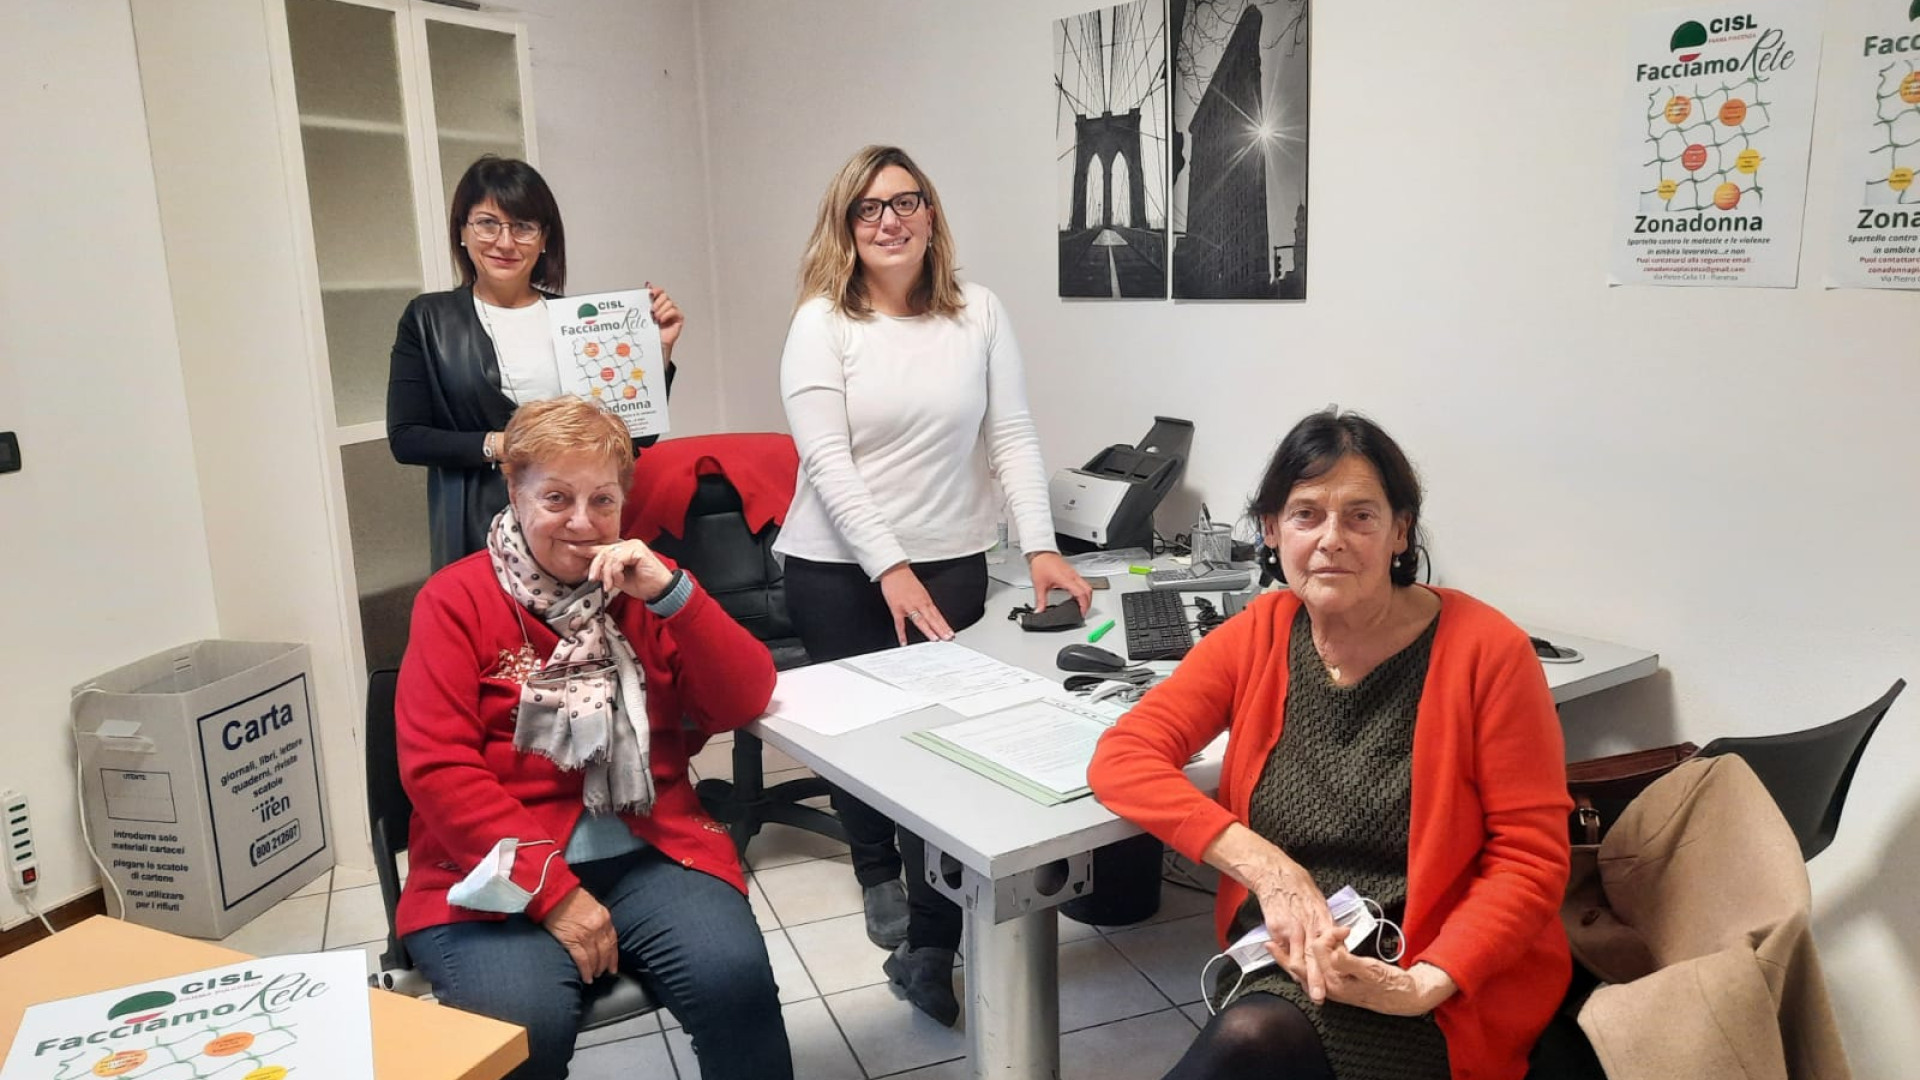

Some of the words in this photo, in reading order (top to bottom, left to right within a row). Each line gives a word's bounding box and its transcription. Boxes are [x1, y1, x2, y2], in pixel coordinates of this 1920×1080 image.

[1710, 14, 1758, 34] CISL
[1637, 57, 1739, 82] Facciamo
[1740, 28, 1796, 82] Rete
[1634, 213, 1763, 233] Zonadonna
[1848, 234, 1886, 244] Sportello
[1888, 233, 1918, 242] contro
[1884, 245, 1916, 254] ambito
[598, 300, 625, 310] CISL
[561, 321, 620, 336] Facciamo
[621, 307, 648, 335] Rete
[222, 703, 293, 750] Carta
[220, 760, 258, 786] giornali,
[259, 749, 278, 766] libri,
[280, 738, 303, 755] lettere
[231, 768, 272, 795] quaderni,
[274, 755, 298, 773] riviste
[253, 777, 283, 798] scatole
[260, 796, 290, 823] iren
[113, 829, 157, 841] introdurre
[158, 834, 178, 842] solo
[256, 841, 271, 859] 800
[271, 824, 298, 849] 212607
[111, 842, 148, 852] materiali
[149, 846, 185, 854] cartacei
[113, 858, 145, 869] piegare
[147, 860, 155, 869] le
[157, 862, 189, 872] scatole
[131, 871, 139, 879] di
[141, 874, 174, 883] cartone
[126, 889, 144, 897] non
[145, 889, 185, 900] utilizzare
[135, 901, 150, 909] per
[156, 902, 180, 912] rifiuti
[180, 970, 263, 995] CISL
[34, 1003, 236, 1057] Facciamo
[238, 972, 330, 1014] Rete
